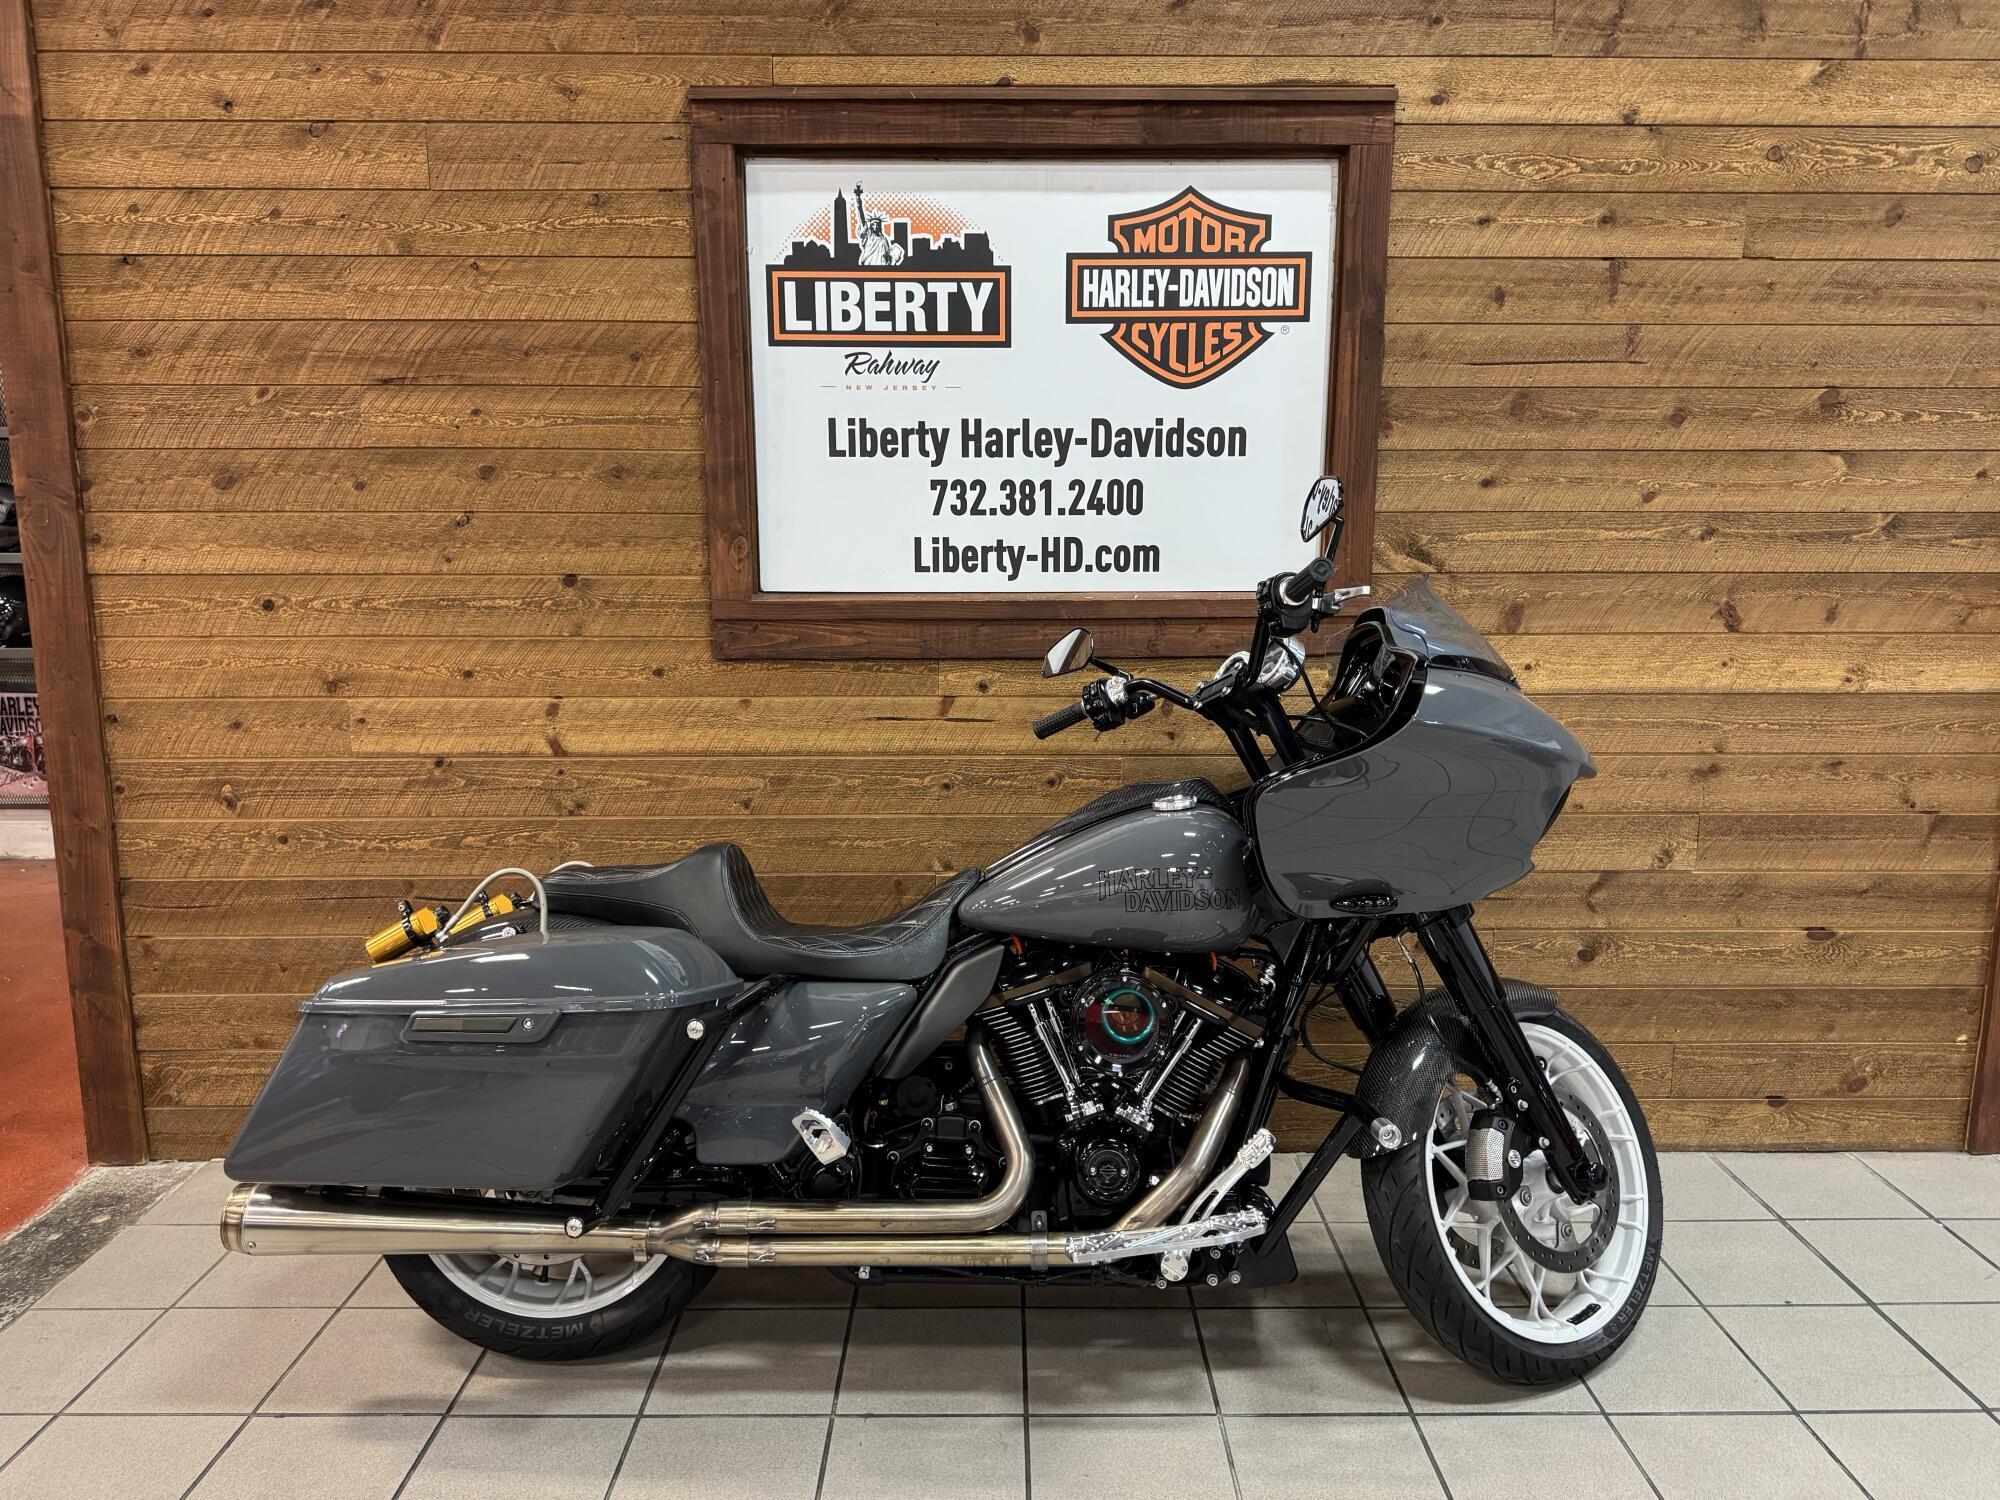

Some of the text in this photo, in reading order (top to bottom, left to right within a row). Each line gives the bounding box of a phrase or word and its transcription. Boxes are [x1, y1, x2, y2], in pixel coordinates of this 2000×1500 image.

[1133, 206, 1246, 253] MOTOR
[783, 280, 994, 332] LIBERTY
[1082, 266, 1295, 308] HARLEY-DAVIDSON
[844, 350, 941, 384] Rahway
[1131, 322, 1243, 374] CYCLES
[827, 417, 1248, 468] Liberty Harley-Davidson
[930, 478, 1144, 517] 732.381.2400
[914, 536, 1160, 582] Liberty-HD.com
[0, 697, 40, 716] ARLEY
[1125, 889, 1240, 912] DAVIDSON
[1616, 1247, 1656, 1324] METZELER
[464, 1309, 584, 1340] METZELER
